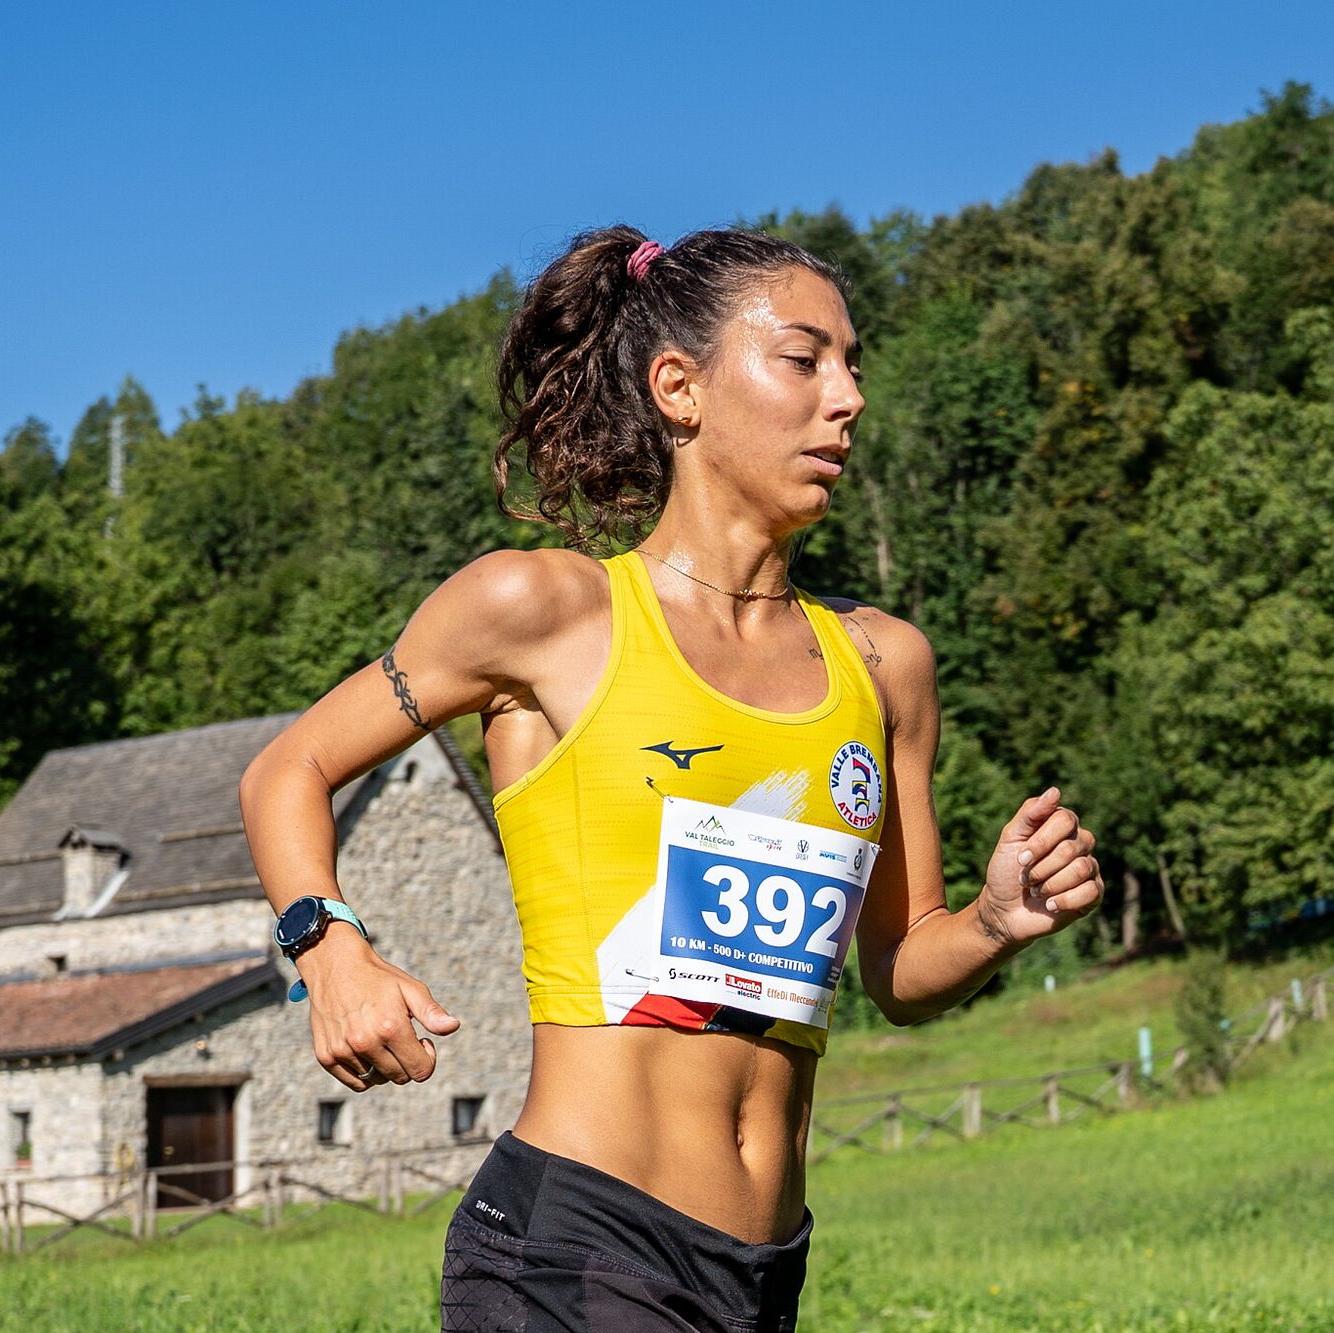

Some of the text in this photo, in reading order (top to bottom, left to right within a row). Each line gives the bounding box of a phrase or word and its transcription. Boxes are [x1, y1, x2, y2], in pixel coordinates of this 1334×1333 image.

[831, 749, 849, 788] VALLE
[838, 802, 877, 826] ATLETICA
[701, 864, 847, 958] 392
[670, 937, 686, 948] 10
[689, 938, 706, 951] KM
[713, 944, 732, 958] 500
[733, 950, 747, 960] D+
[748, 952, 814, 974] COMPETITIVO
[678, 972, 720, 983] SCOTT
[732, 974, 761, 992] Lovato
[737, 990, 761, 1001] electric
[475, 1199, 506, 1222] DRI-FIT
